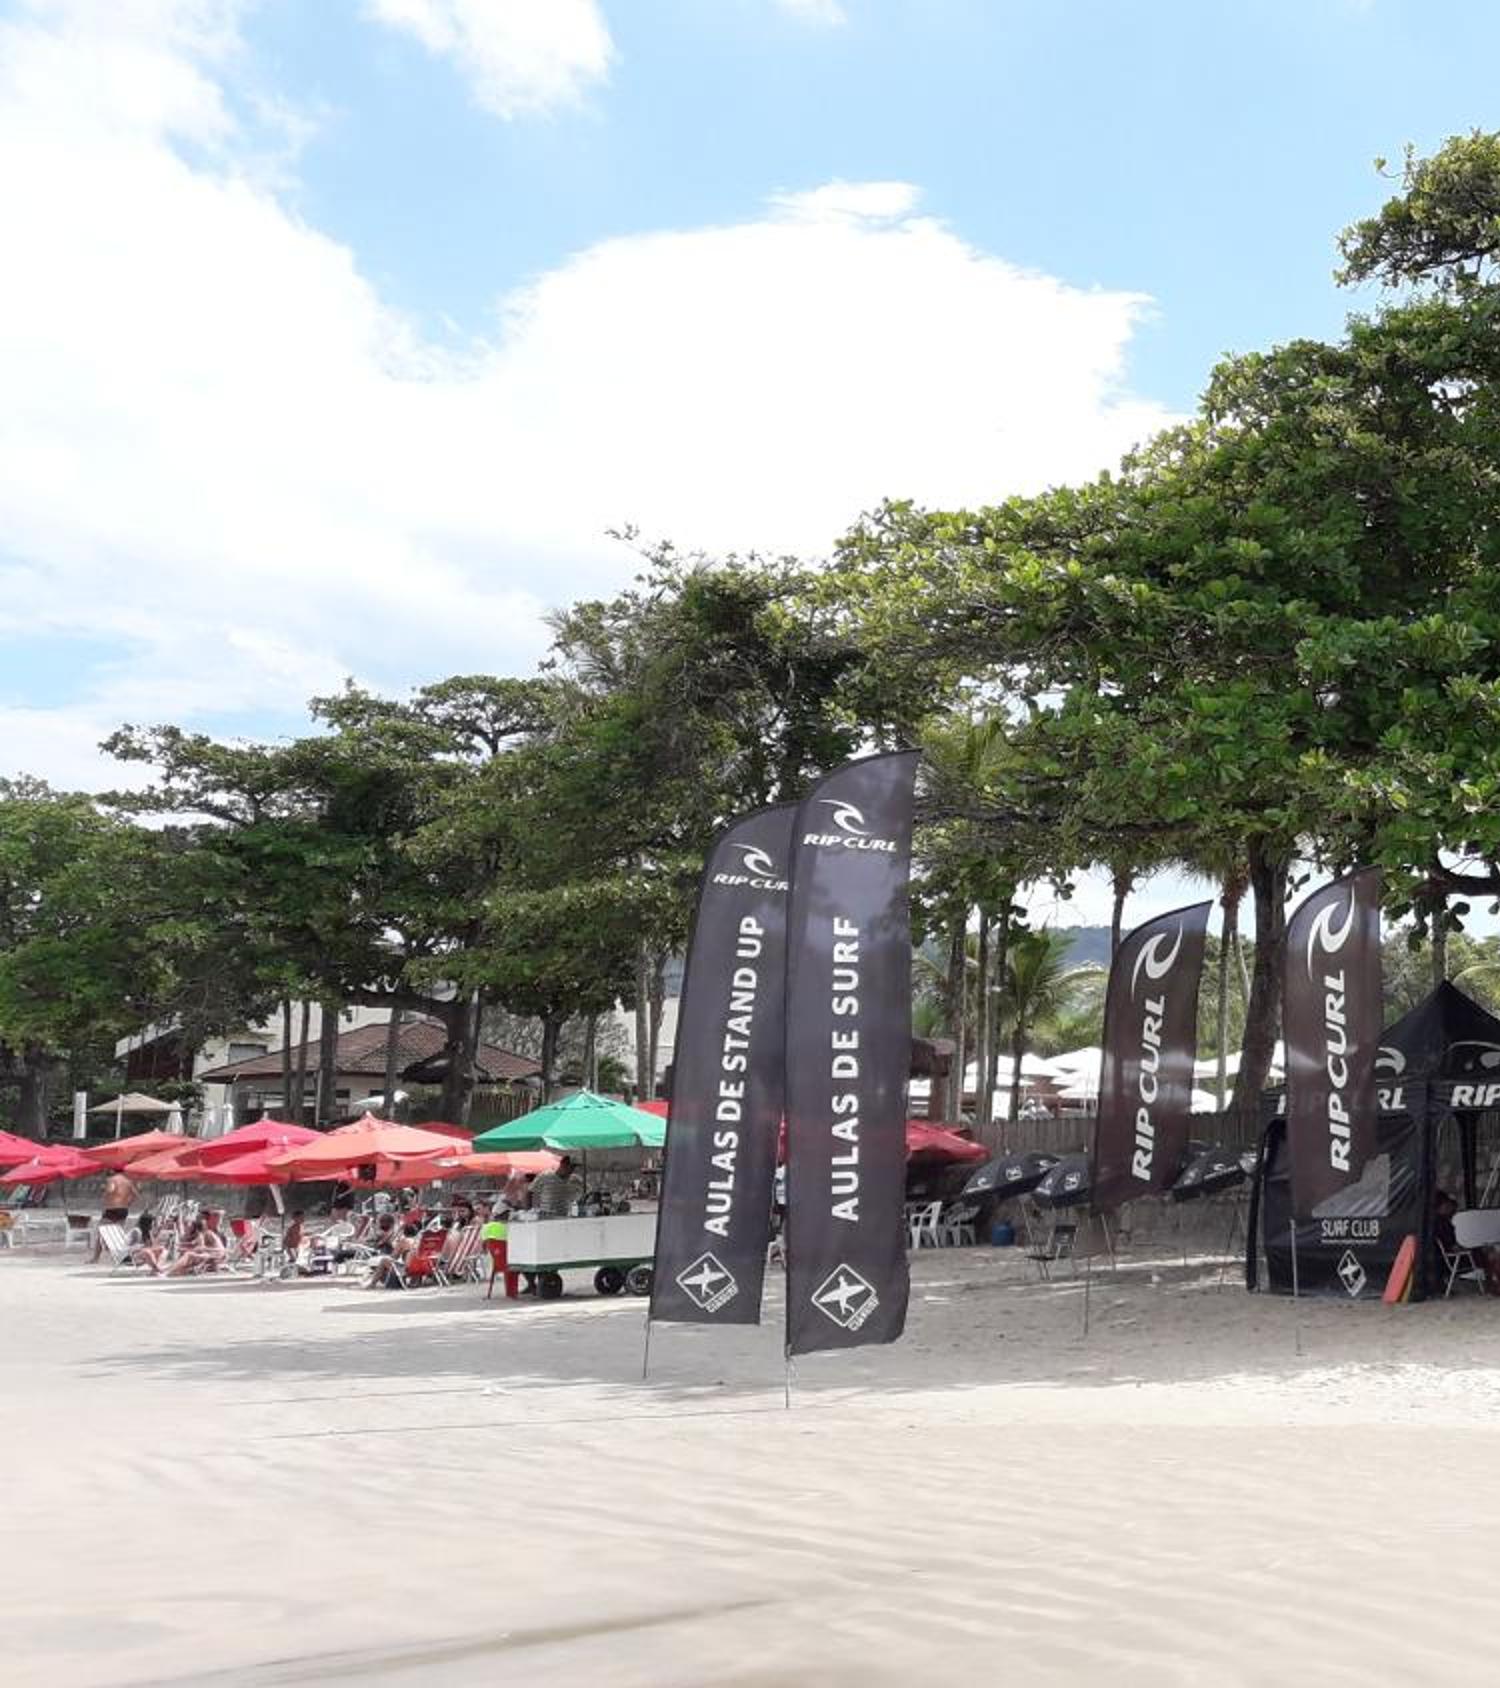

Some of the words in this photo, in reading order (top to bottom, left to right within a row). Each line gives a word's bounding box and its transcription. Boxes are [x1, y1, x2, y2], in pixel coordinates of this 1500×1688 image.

[803, 833, 841, 847] RIP
[843, 836, 897, 852] CURL
[713, 873, 748, 886] RIP
[750, 880, 789, 892] CUR
[736, 916, 764, 958] UP
[831, 916, 859, 1015] SURF
[722, 967, 757, 1072] STAND
[831, 1030, 859, 1078] DE
[1139, 995, 1165, 1104] CURL
[1324, 969, 1348, 1089] CURL
[716, 1080, 745, 1121] DE
[1326, 1092, 1350, 1172] RIP
[1377, 1087, 1406, 1110] RL
[831, 1093, 859, 1222] AULAS
[1132, 1107, 1155, 1181] RIP
[704, 1131, 739, 1237] AULAS
[1321, 1219, 1350, 1237] SURF
[1352, 1219, 1379, 1237] CLUB
